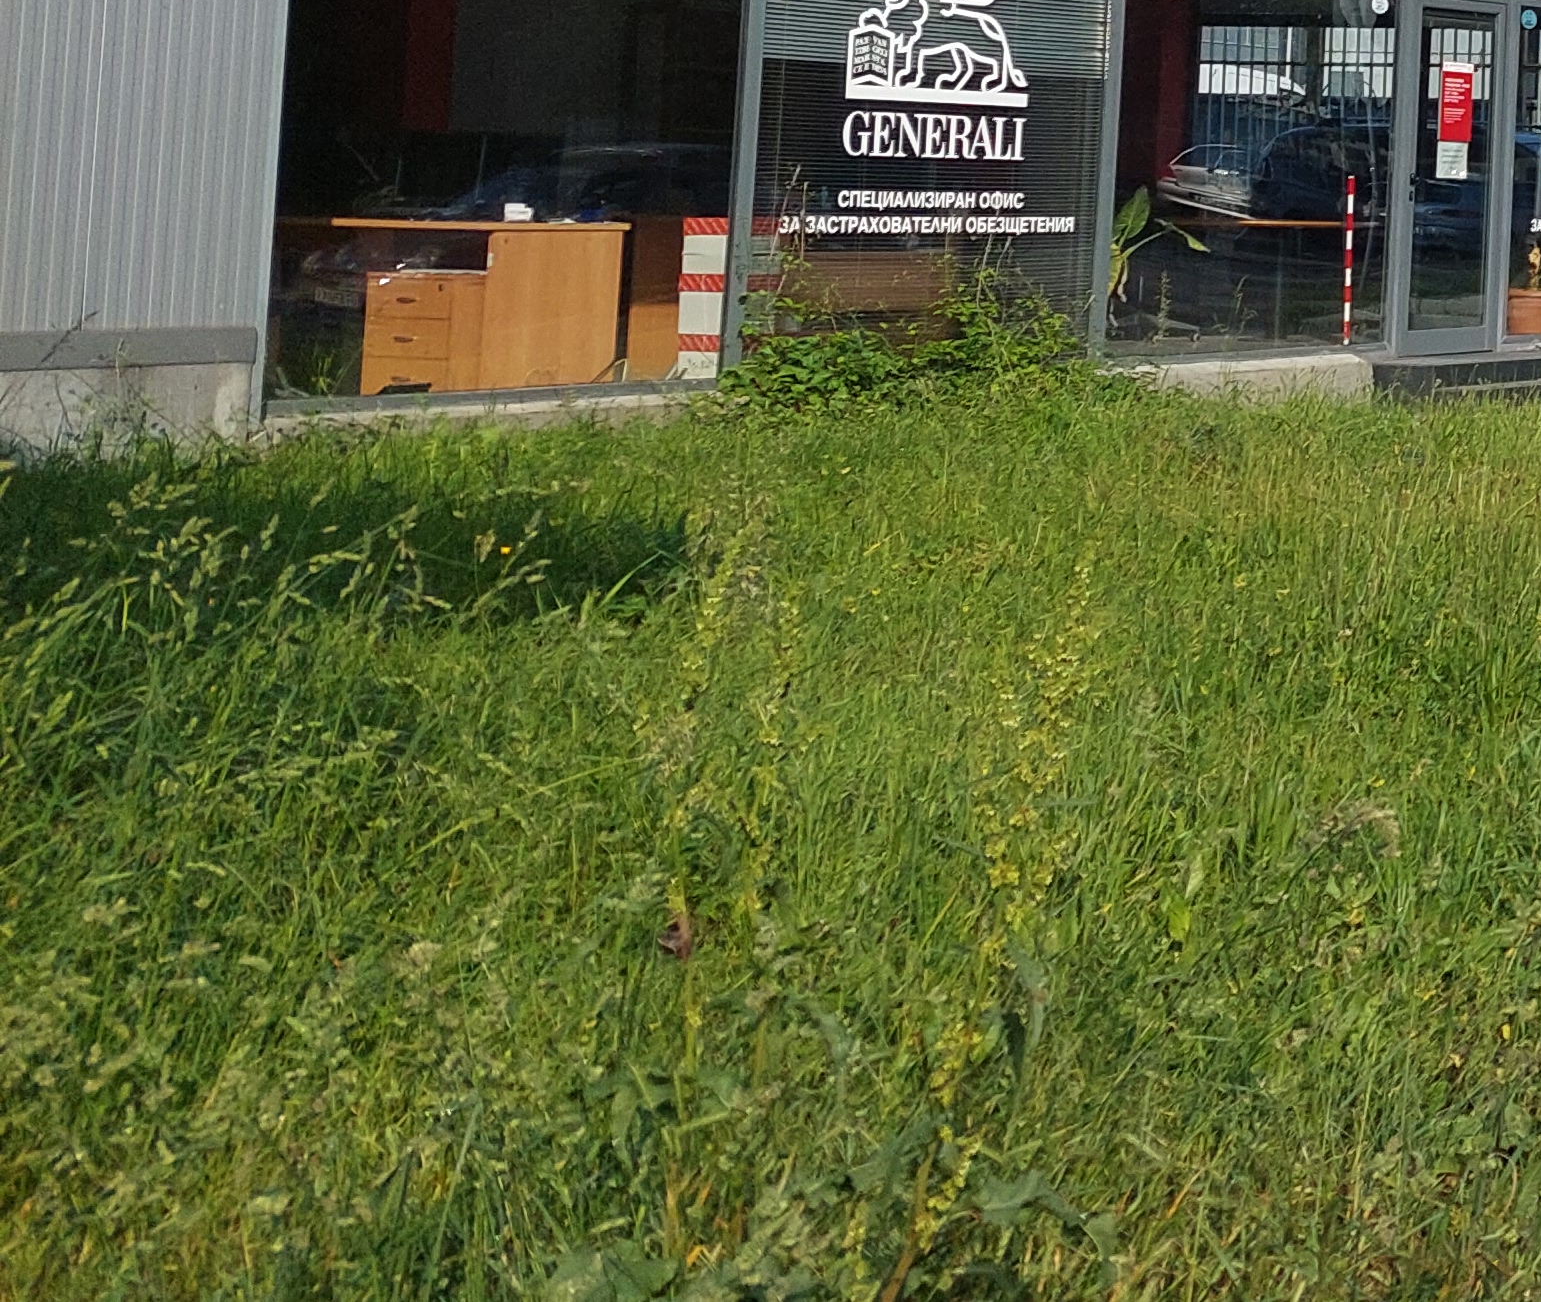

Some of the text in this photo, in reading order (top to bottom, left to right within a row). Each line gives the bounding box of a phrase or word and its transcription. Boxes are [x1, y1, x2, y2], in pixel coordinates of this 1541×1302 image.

[842, 110, 1028, 162] GENERALI
[837, 190, 1025, 210] СПЕЦИАЛИЗИРАН ОФИС
[778, 215, 1075, 235] ЗА ЗАСТРАХОВАТЕЛНИ ОБЕЗЩЕТЕНИЯ
